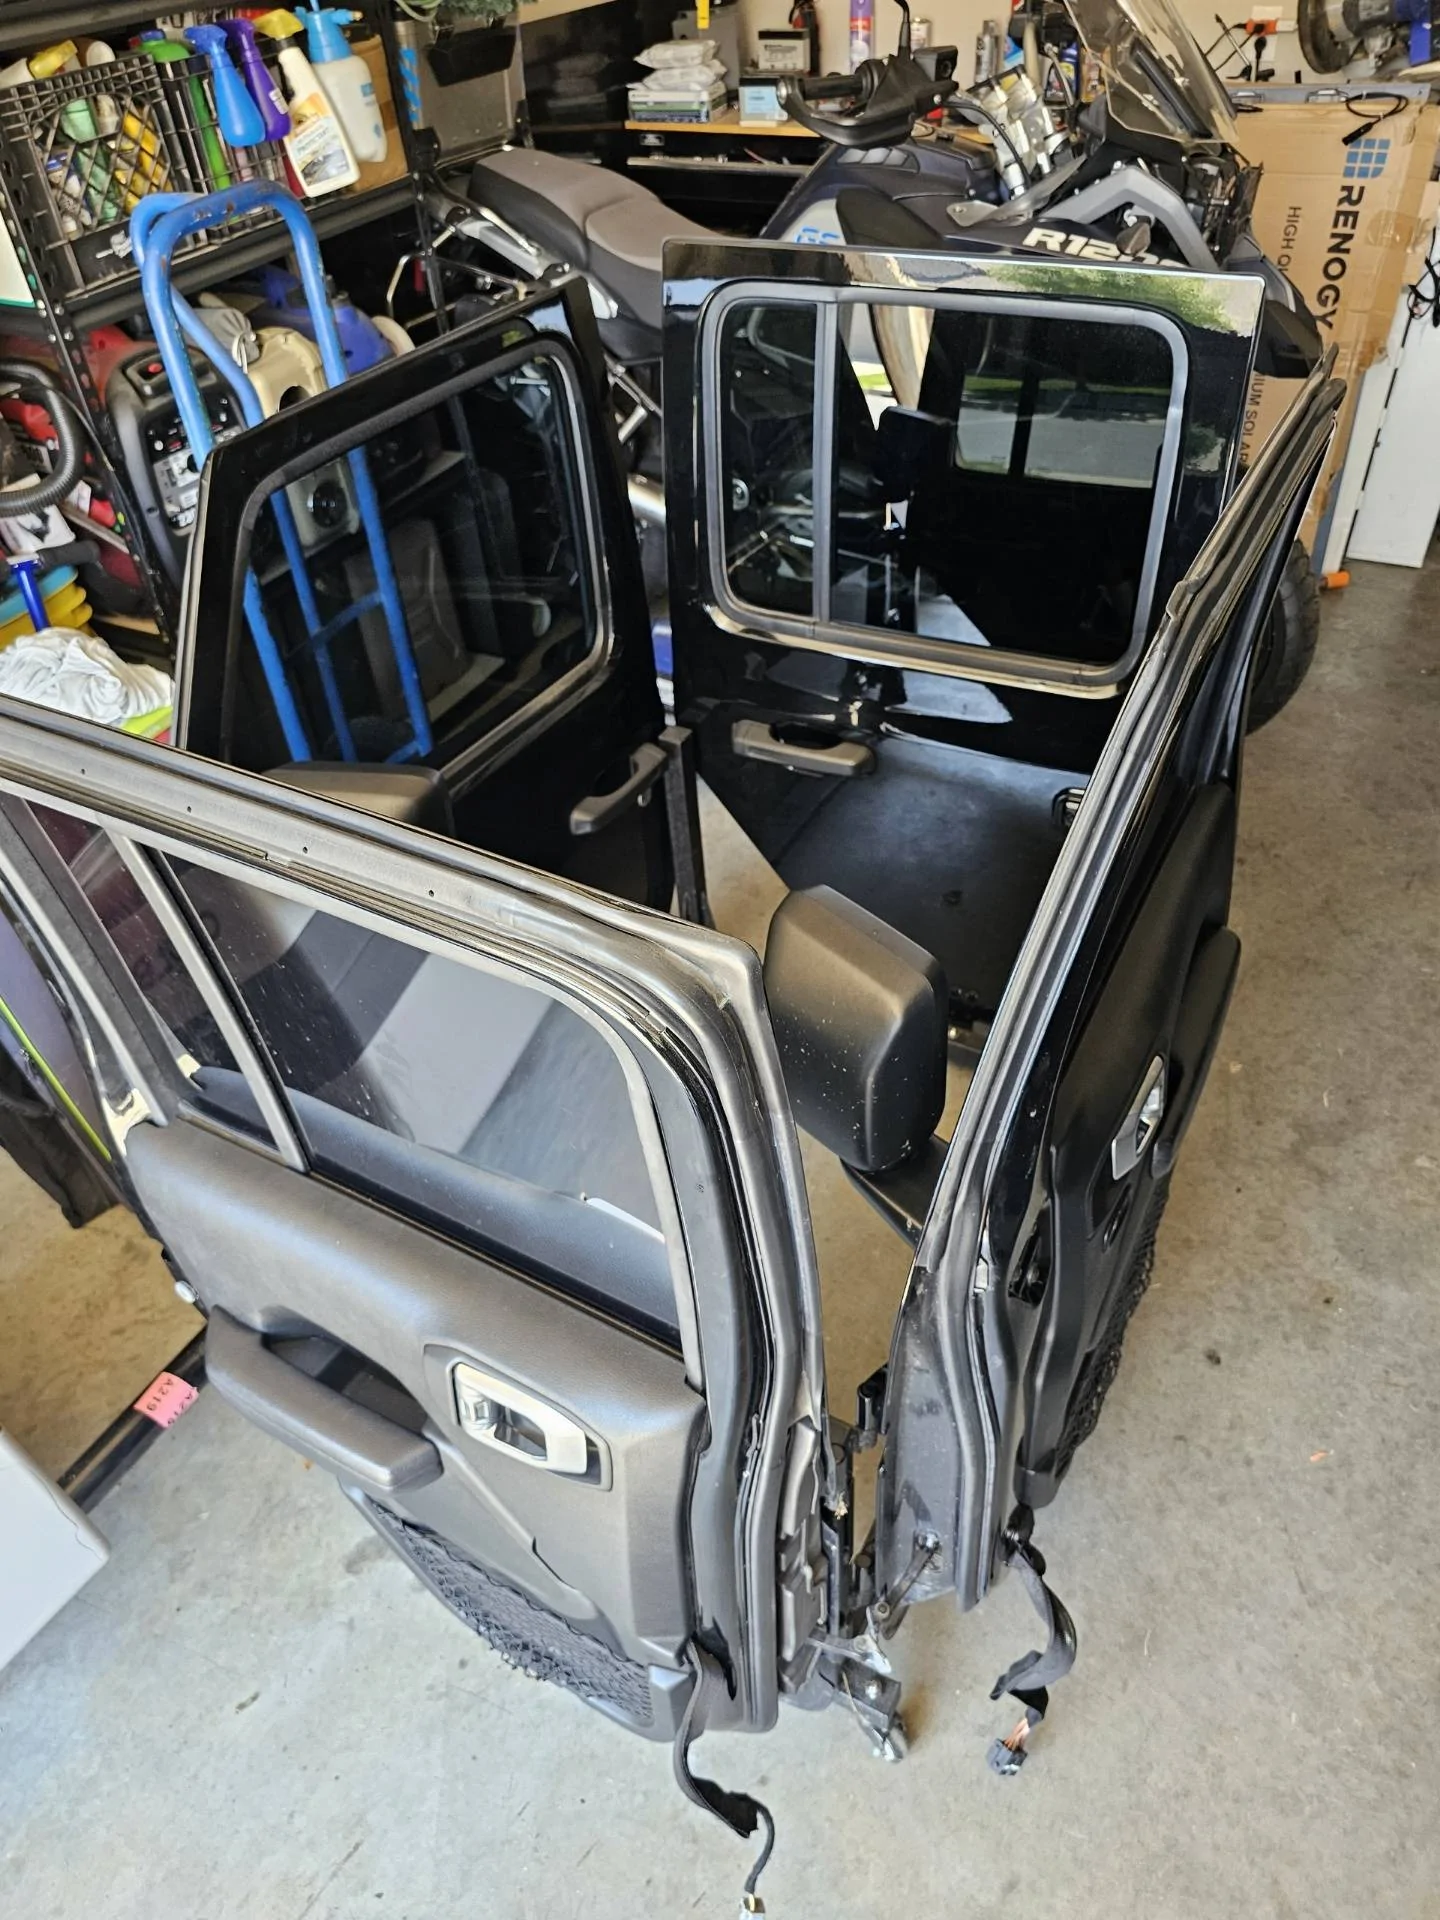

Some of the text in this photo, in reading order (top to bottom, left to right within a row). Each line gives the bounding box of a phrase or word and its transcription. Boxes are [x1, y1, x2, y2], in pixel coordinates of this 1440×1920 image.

[1281, 206, 1302, 250] HIGH
[1316, 185, 1366, 330] RENOGY
[146, 1378, 174, 1412] A219
